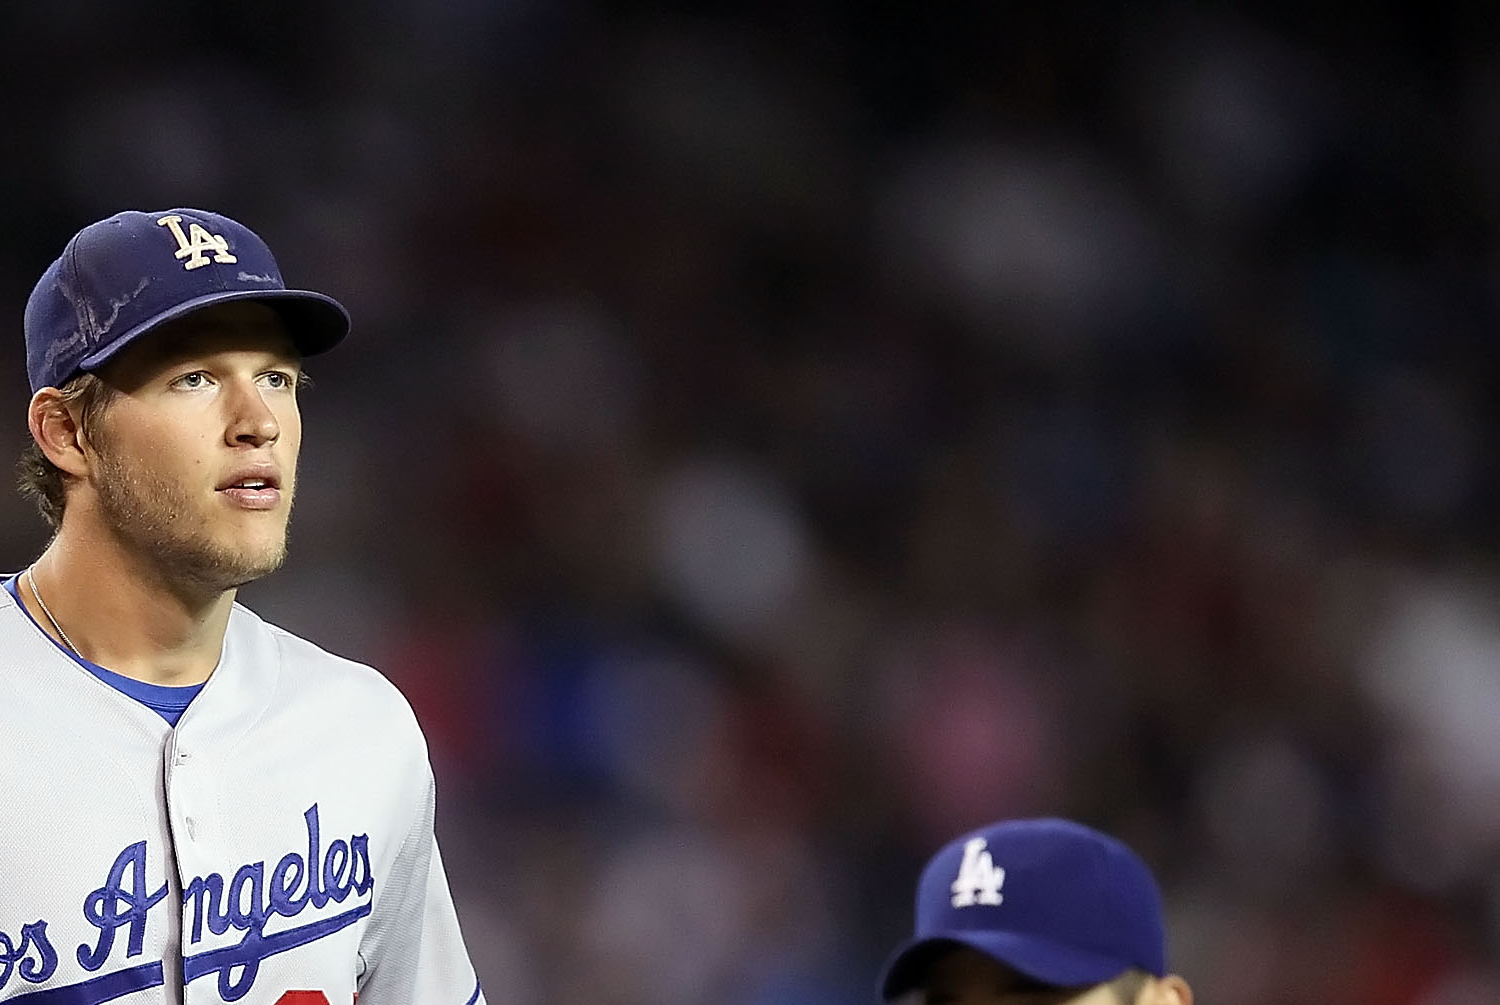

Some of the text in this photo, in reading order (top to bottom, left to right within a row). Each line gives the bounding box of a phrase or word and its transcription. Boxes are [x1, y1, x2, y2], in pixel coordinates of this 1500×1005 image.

[157, 215, 238, 270] LA
[77, 802, 374, 1003] Angeles
[952, 837, 1006, 908] LA
